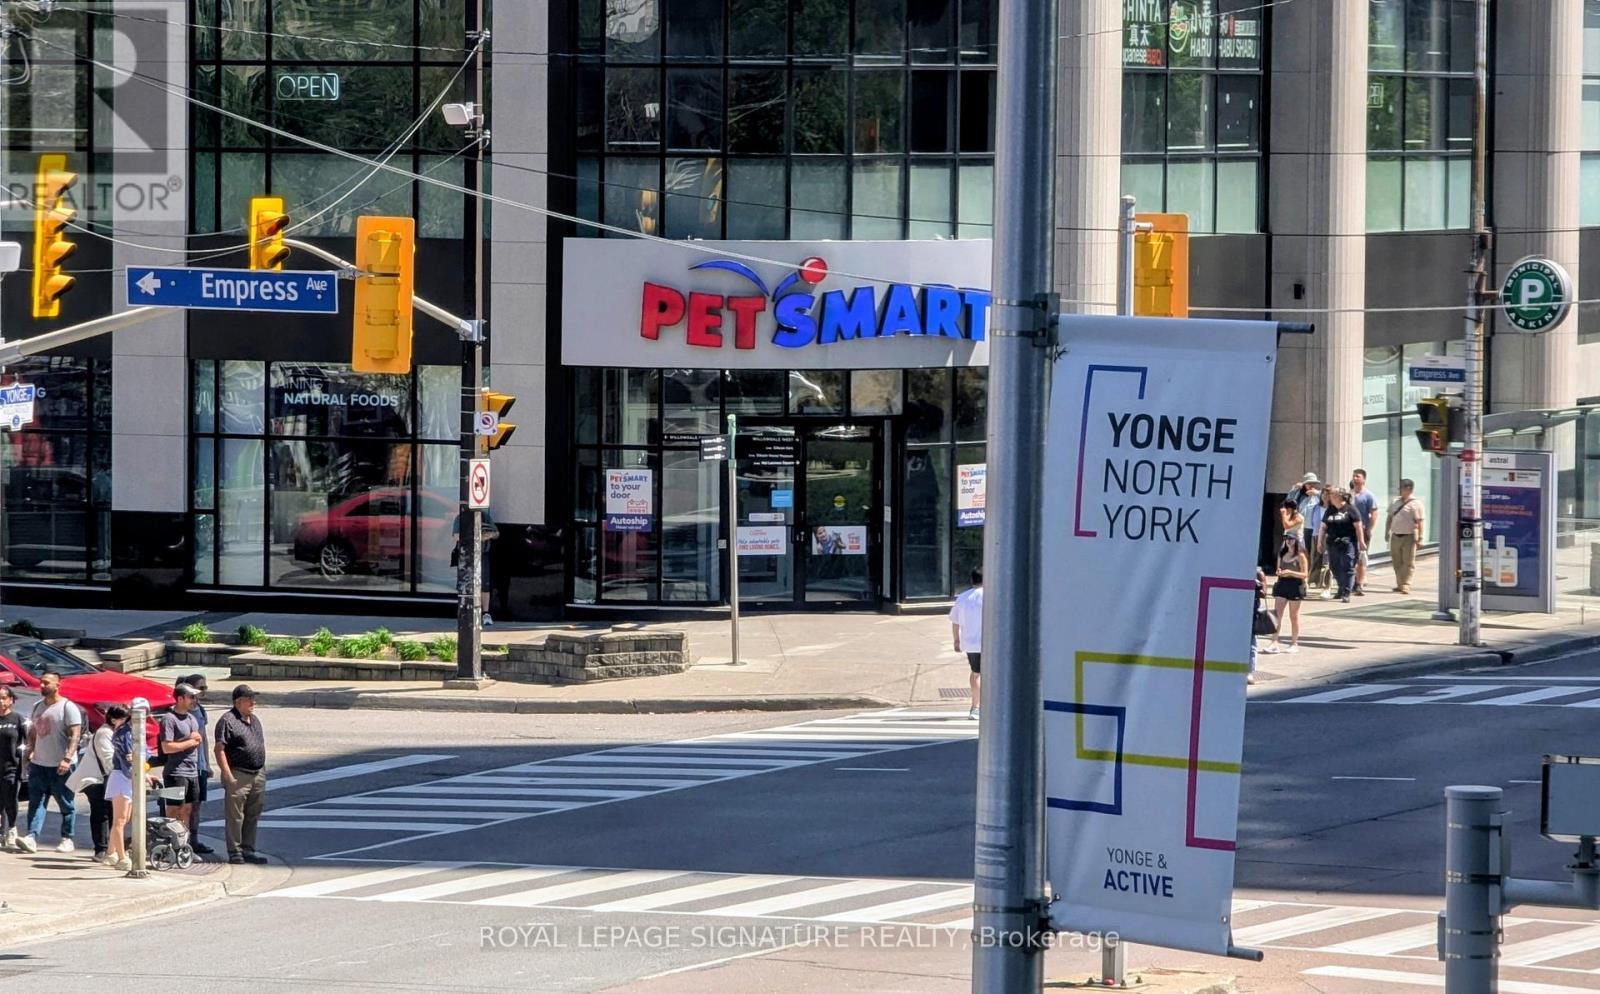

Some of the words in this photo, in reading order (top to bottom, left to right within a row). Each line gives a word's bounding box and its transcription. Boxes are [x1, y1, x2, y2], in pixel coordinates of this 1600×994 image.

[1190, 38, 1213, 57] HARU
[279, 76, 336, 97] OPEN
[1506, 263, 1559, 288] MUNICIPAL
[202, 272, 298, 305] Empress
[306, 276, 328, 291] Ave
[1521, 278, 1545, 306] P
[639, 283, 991, 350] PETSMART
[1413, 368, 1447, 380] Empress
[284, 392, 347, 406] NATURAL
[350, 393, 399, 407] FOODS
[1107, 412, 1237, 454] YONGE
[622, 484, 641, 492] your
[1103, 458, 1233, 500] NORTH
[610, 490, 631, 499] door
[610, 516, 648, 527] Autoship
[1102, 503, 1200, 544] YORK
[1106, 847, 1153, 868] YONGE
[1157, 853, 1168, 869] &
[1103, 869, 1174, 898] ACTIVE
